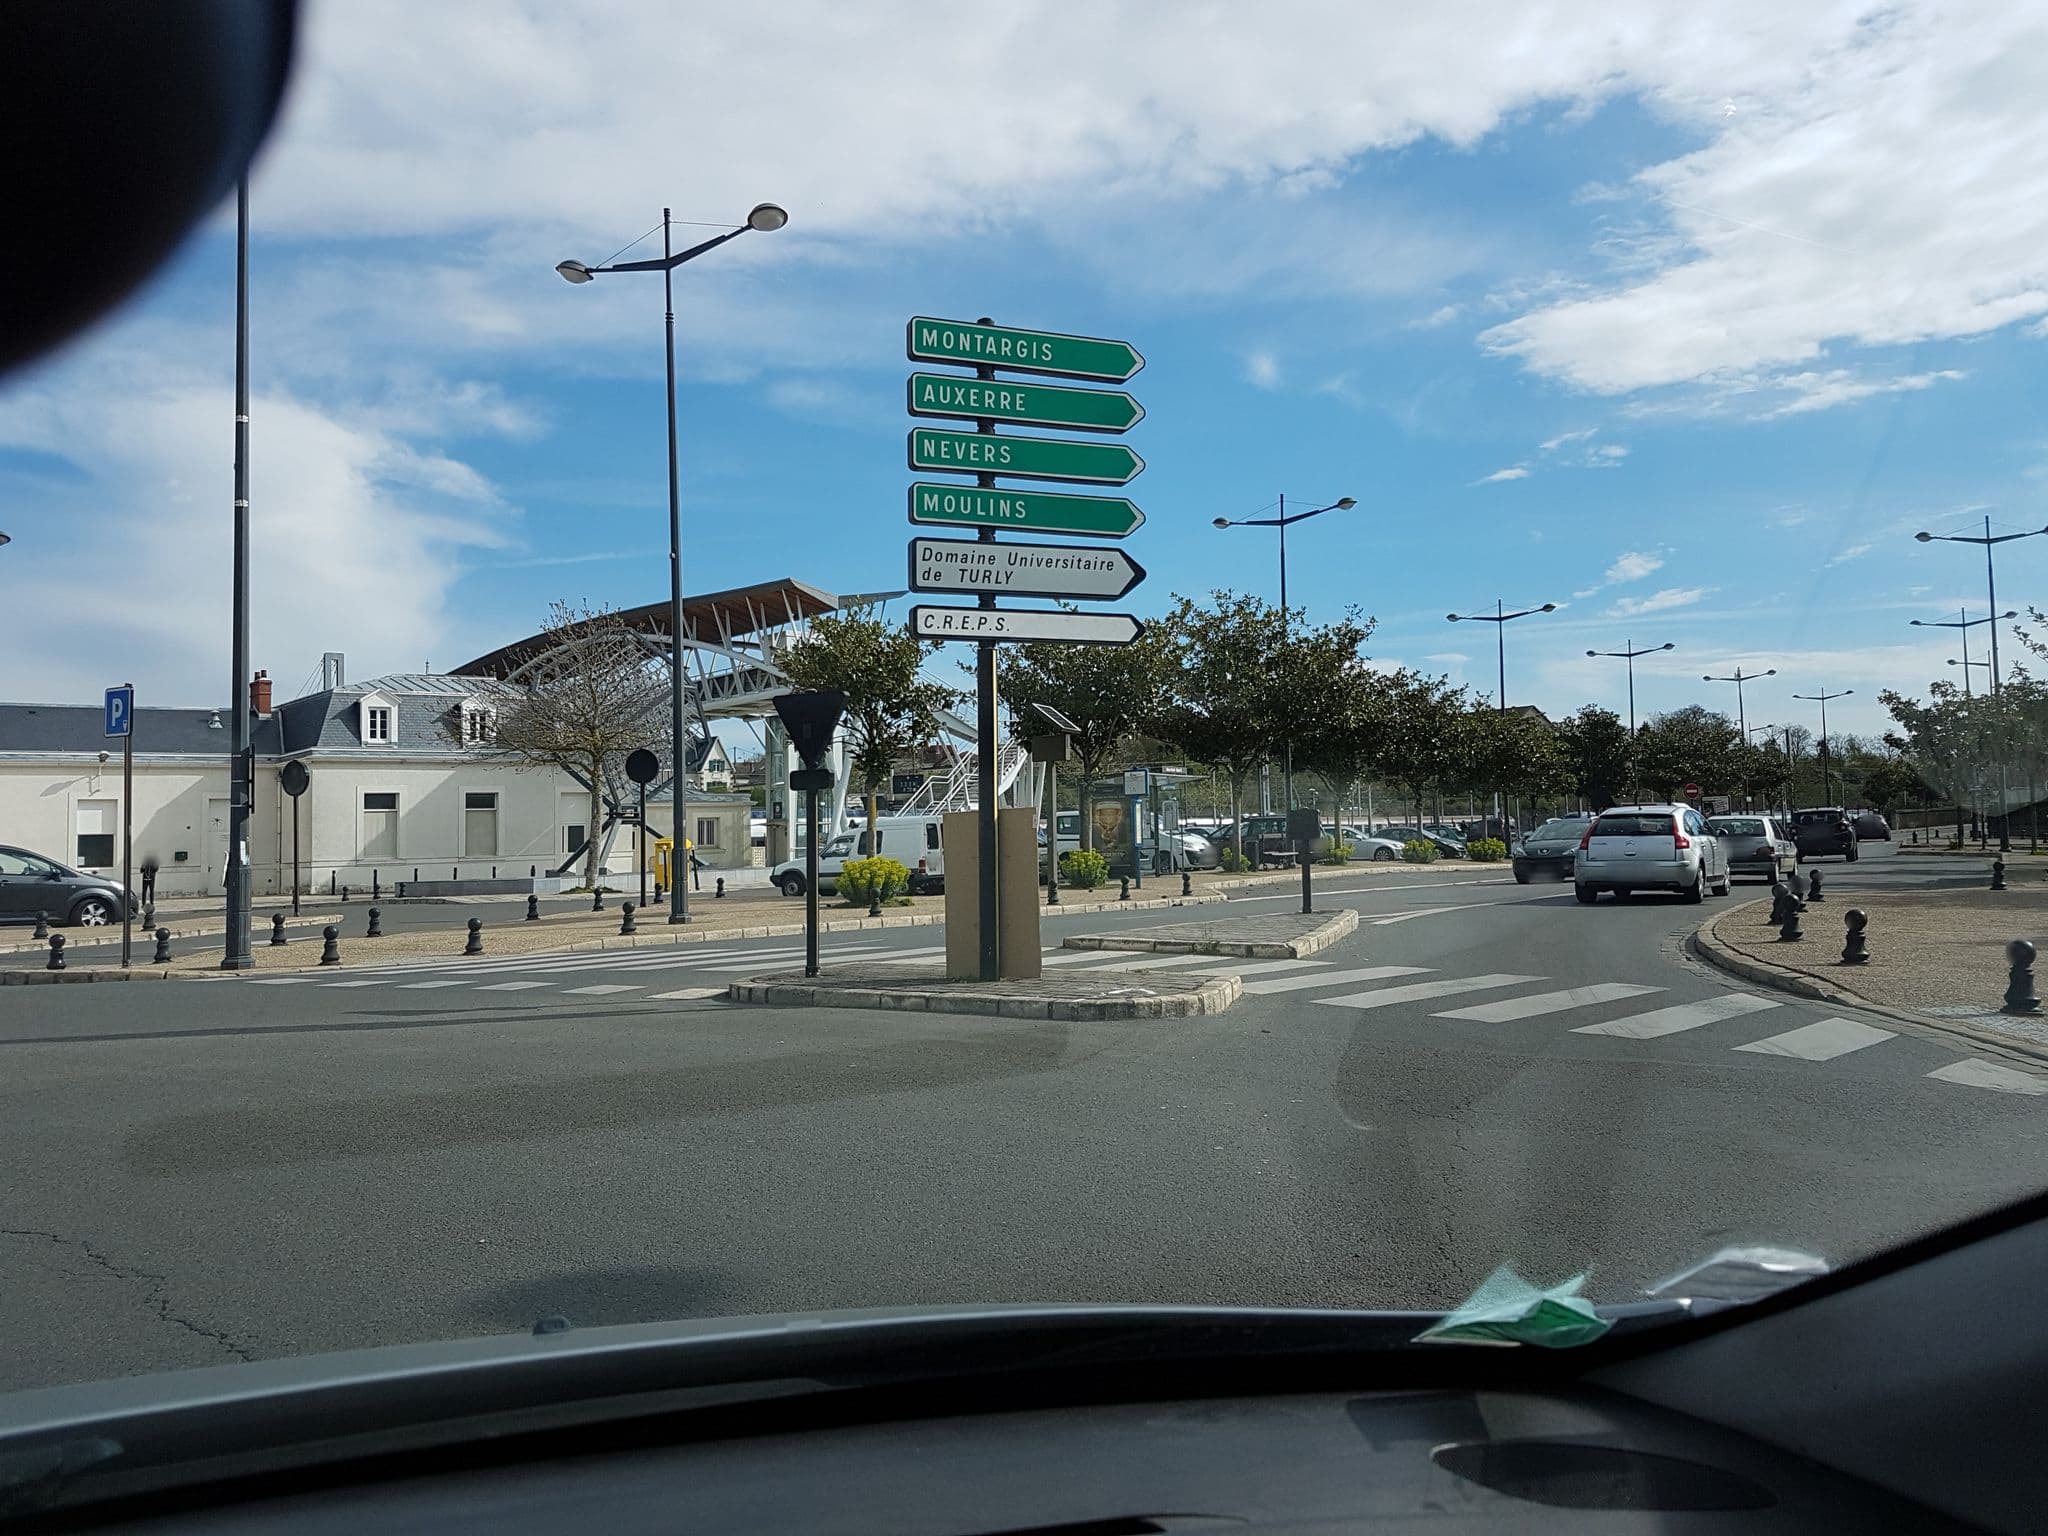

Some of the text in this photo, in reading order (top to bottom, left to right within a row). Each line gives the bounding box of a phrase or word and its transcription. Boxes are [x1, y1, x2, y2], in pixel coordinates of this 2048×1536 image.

[922, 328, 1053, 361] MONTARGIS
[923, 384, 1026, 412] AUXERRE
[924, 439, 1011, 464] NEVERS
[923, 493, 1027, 519] MOULINS
[921, 547, 1115, 571] Domaine Universitaire
[922, 568, 1014, 585] de TURLY
[924, 614, 1010, 632] C.R.E.P.S.
[112, 698, 123, 727] P
